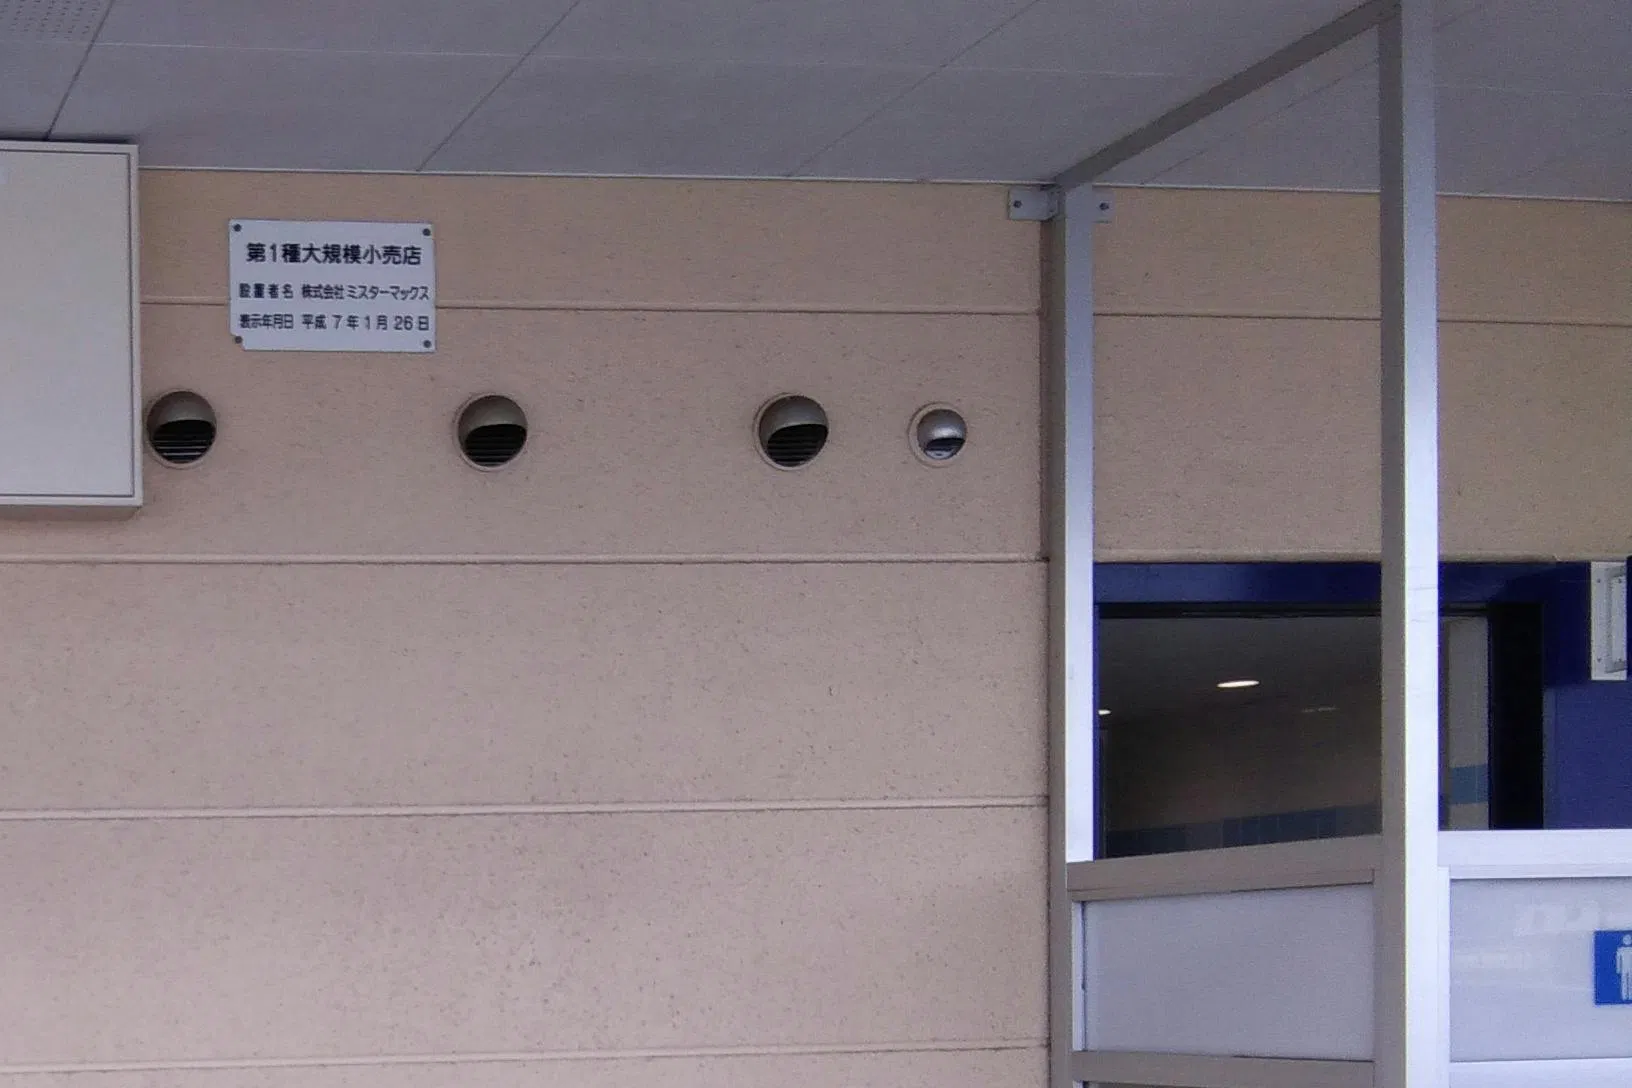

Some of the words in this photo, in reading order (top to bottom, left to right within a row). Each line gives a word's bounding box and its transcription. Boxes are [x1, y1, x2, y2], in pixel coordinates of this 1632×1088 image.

[245, 242, 422, 266] 第1種大規模小売店
